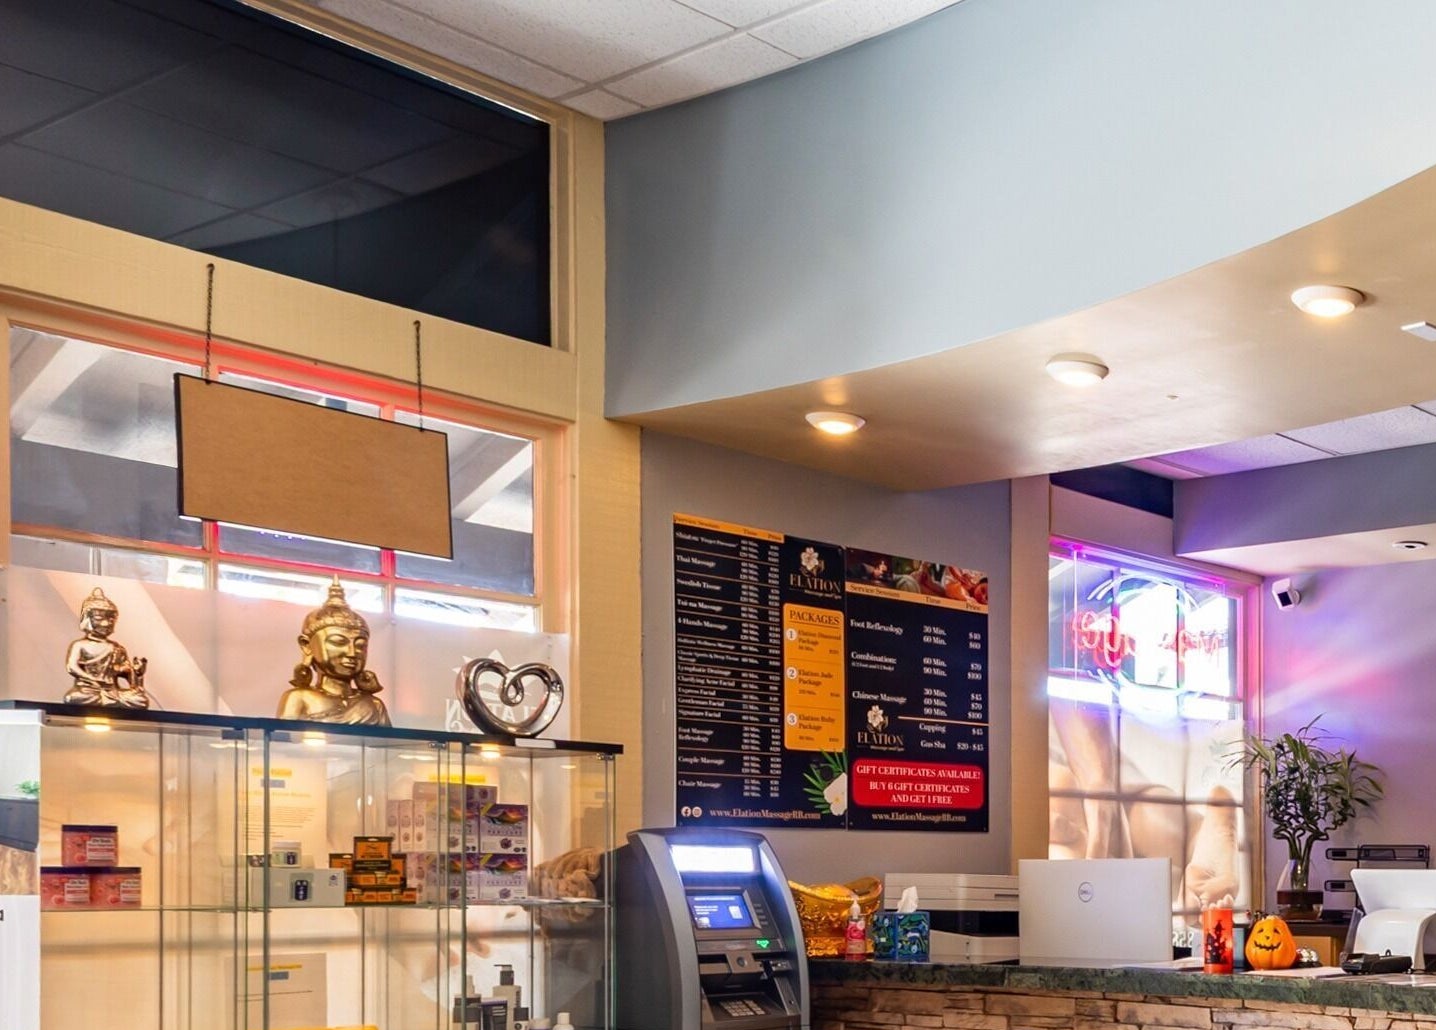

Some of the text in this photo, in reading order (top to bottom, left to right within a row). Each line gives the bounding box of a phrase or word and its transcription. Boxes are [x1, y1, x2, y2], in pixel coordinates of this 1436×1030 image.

[790, 573, 841, 593] ELATION
[789, 610, 840, 626] PACKAGES
[850, 619, 866, 629] Foot
[866, 620, 904, 636] Reflexology
[923, 626, 934, 634] 30
[934, 627, 946, 636] Min.
[923, 636, 981, 650] 60 Min. $60
[934, 659, 947, 667] Min.
[790, 668, 794, 678] 2
[934, 668, 947, 676] Min.
[852, 690, 880, 700] Chinese
[880, 693, 907, 704] Massage
[934, 690, 948, 698] Min.
[934, 708, 948, 716] Min.
[790, 715, 794, 724] 3
[919, 722, 946, 734] Cupping
[858, 732, 904, 746] ELATION
[956, 742, 969, 750] $20
[856, 765, 980, 780] GIFT CERTIFICATES AVAILABLE!
[870, 782, 970, 794] BUY 6 GIFT CERTIFICATES
[890, 794, 909, 802] AND
[910, 796, 926, 804] GET
[932, 796, 952, 804] FREE
